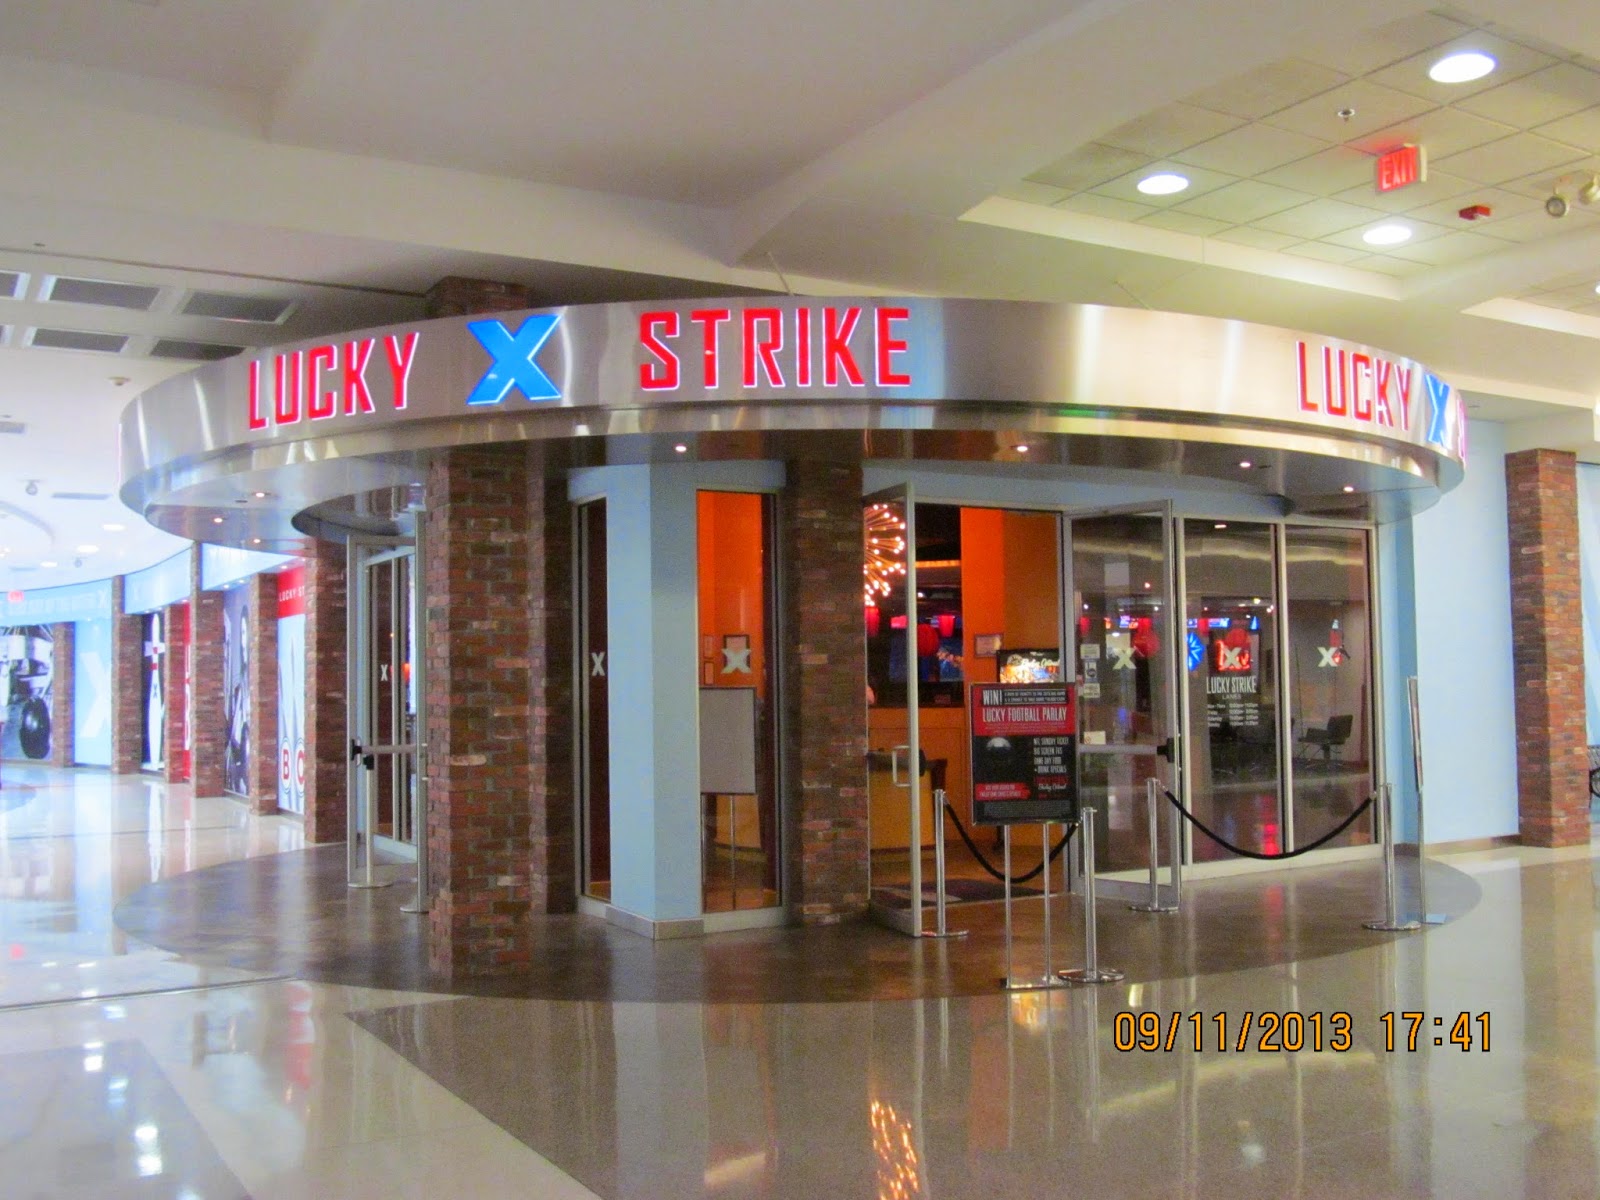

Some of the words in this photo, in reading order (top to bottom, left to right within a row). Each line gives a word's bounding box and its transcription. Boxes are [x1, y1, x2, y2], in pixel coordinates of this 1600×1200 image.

[1381, 152, 1415, 189] EXIT
[249, 332, 419, 430] LUCKY
[639, 306, 911, 391] STRIKE
[1296, 340, 1411, 432] LUCKY
[982, 689, 1003, 706] WIN!
[1207, 676, 1230, 694] LUCKY
[1231, 675, 1257, 693] STRIKE
[982, 707, 1006, 722] LUCKY
[1008, 707, 1041, 722] FOOTBALL
[1042, 706, 1067, 721] PARLAY
